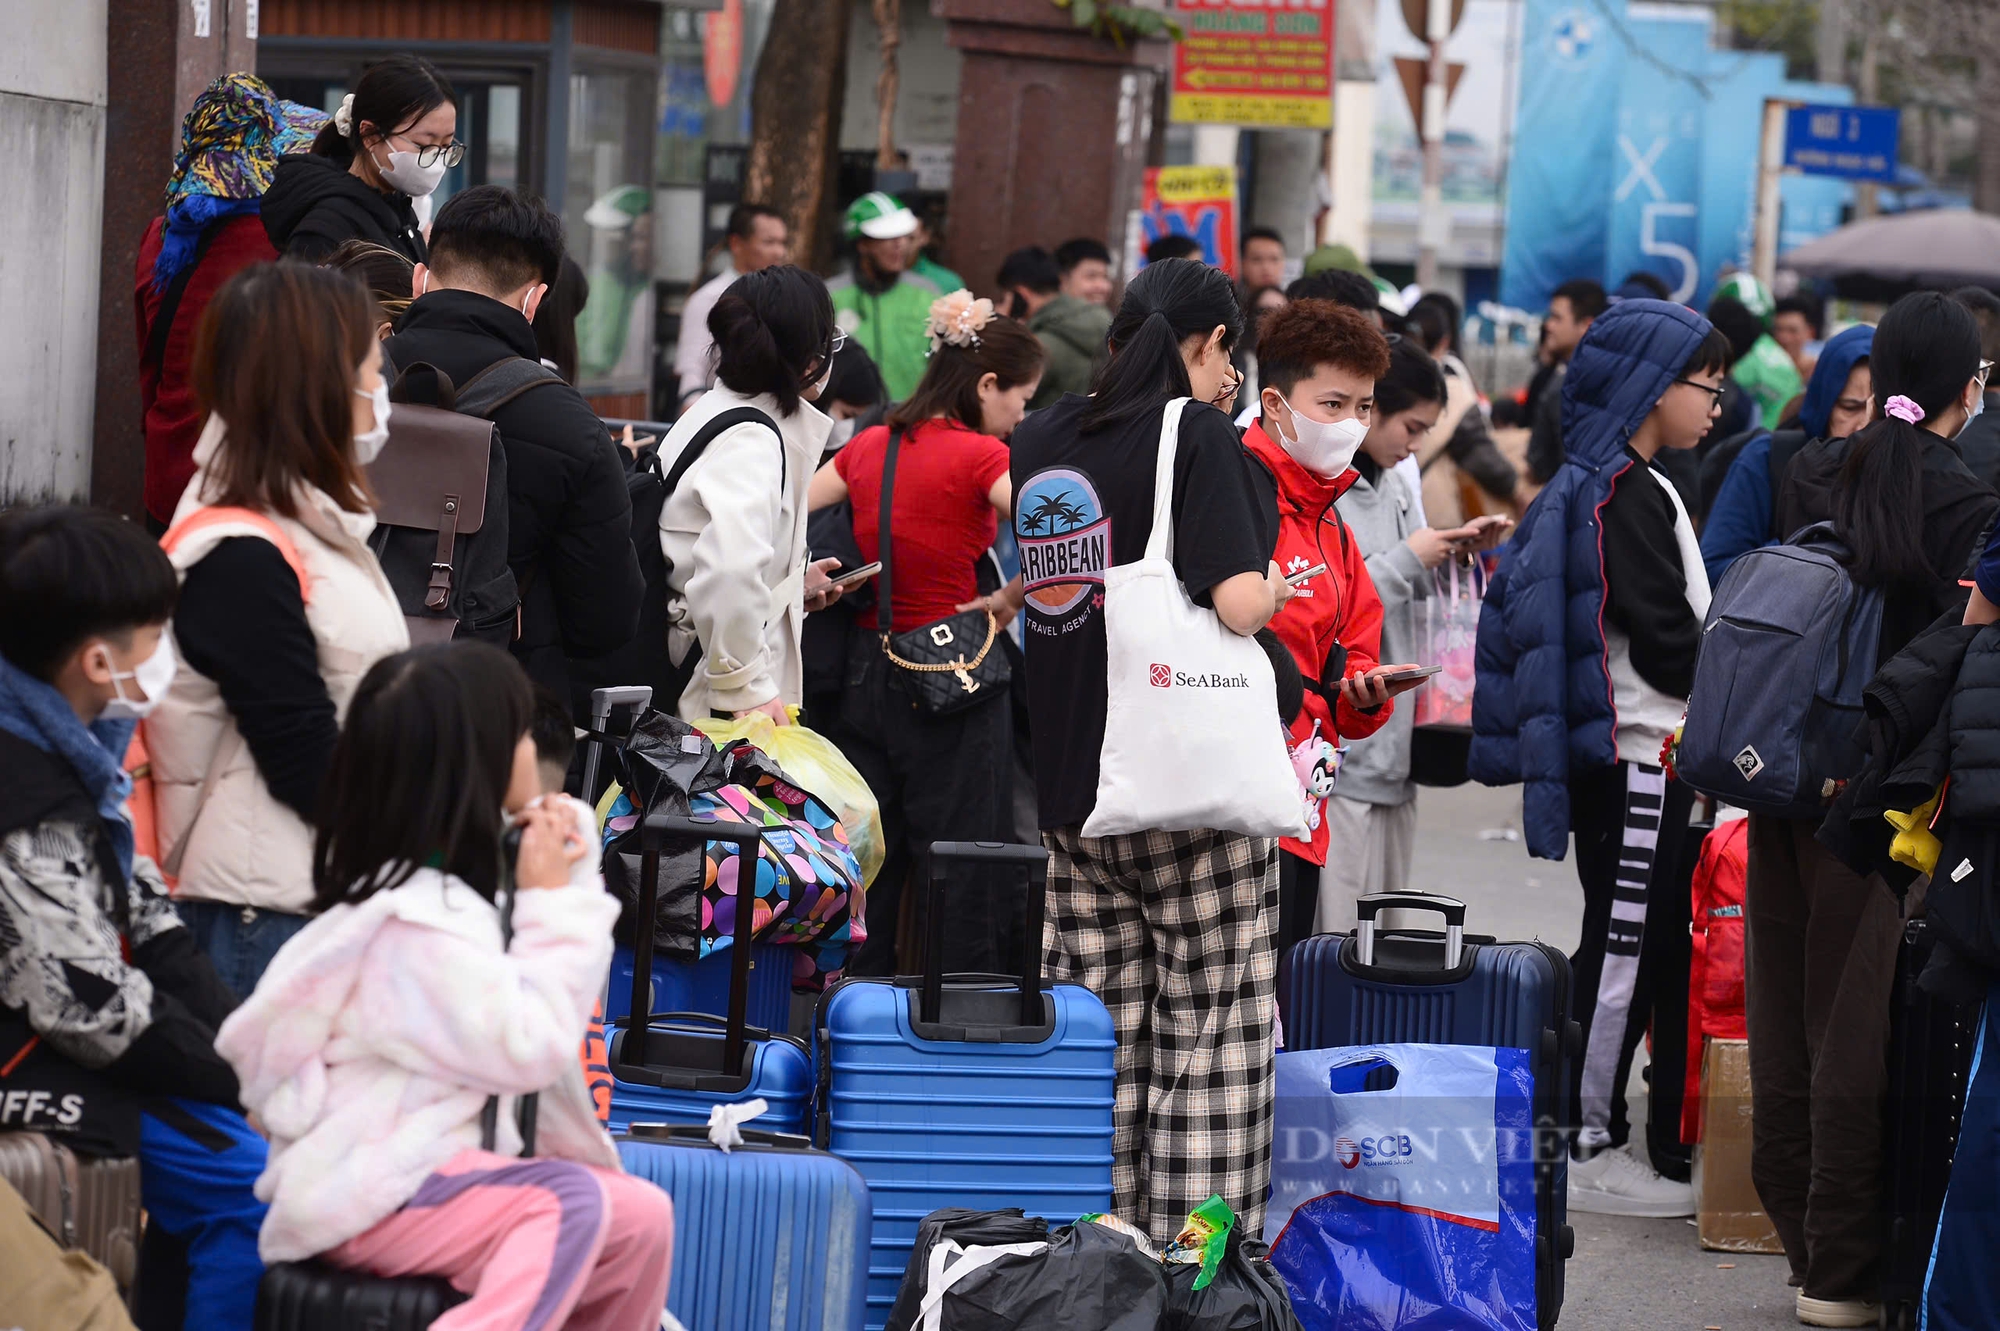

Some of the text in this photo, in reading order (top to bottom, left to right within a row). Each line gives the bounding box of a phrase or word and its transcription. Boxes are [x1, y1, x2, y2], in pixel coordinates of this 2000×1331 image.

[1020, 534, 1104, 582] ARIBBEAN
[1026, 617, 1058, 636] TRAVEL
[1175, 671, 1250, 688] SeABank
[0, 1090, 84, 1125] FF-S
[1361, 1135, 1413, 1159] SCB
